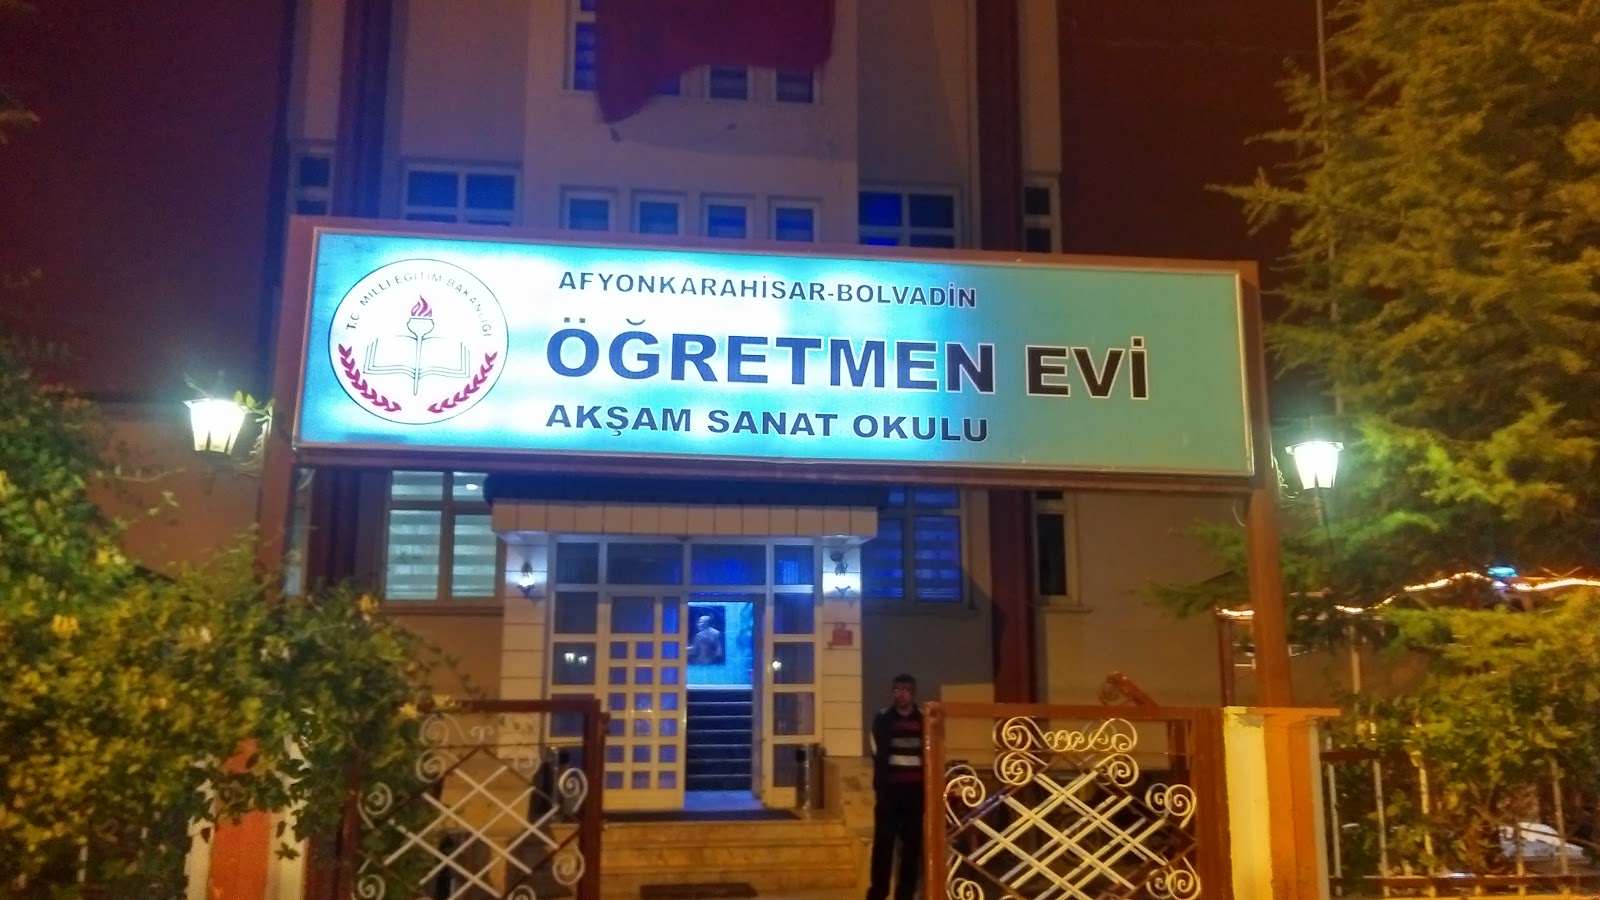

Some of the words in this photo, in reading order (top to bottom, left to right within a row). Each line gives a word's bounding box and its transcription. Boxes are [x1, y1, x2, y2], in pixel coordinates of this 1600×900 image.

[558, 271, 977, 308] AFYONKARAHİSAR-BOLVADİN
[546, 317, 996, 395] ÖĞRETMEN
[1025, 336, 1149, 400] EVİ
[545, 404, 692, 437] AKŞAM
[707, 409, 838, 438] SANAT
[852, 413, 988, 443] OKULU
